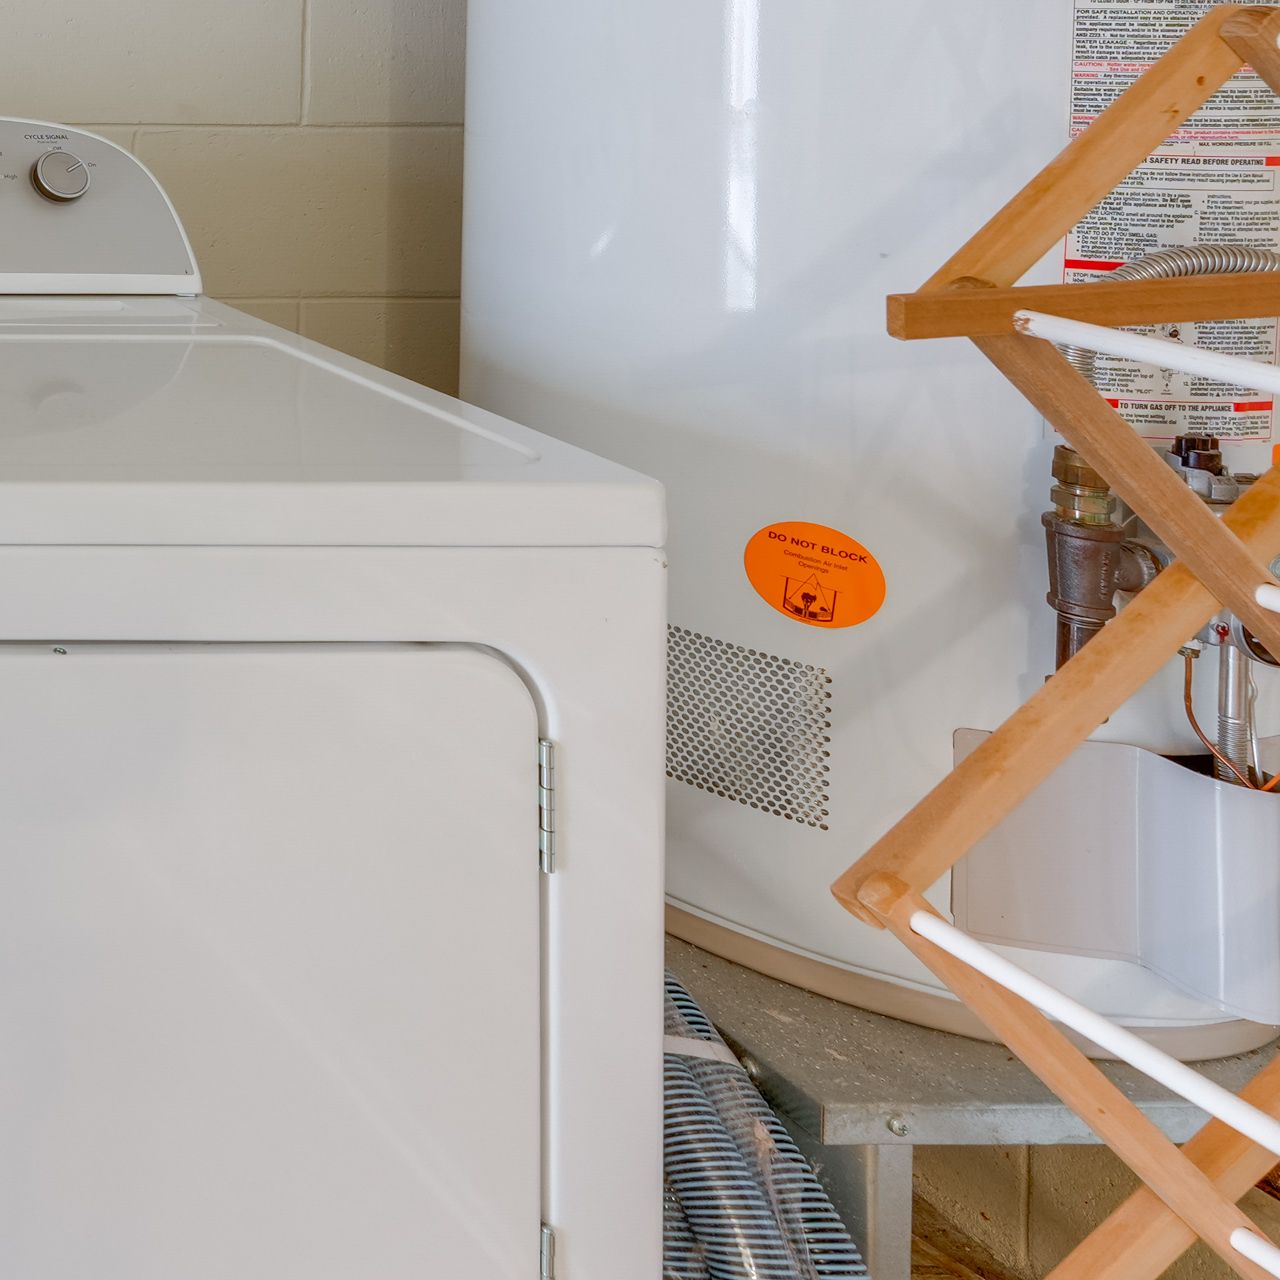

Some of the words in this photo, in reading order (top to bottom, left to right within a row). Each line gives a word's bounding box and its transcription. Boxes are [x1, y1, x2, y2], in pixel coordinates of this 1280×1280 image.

[768, 531, 787, 542] DO
[791, 537, 817, 551] NOT
[821, 545, 867, 564] BLOCK
